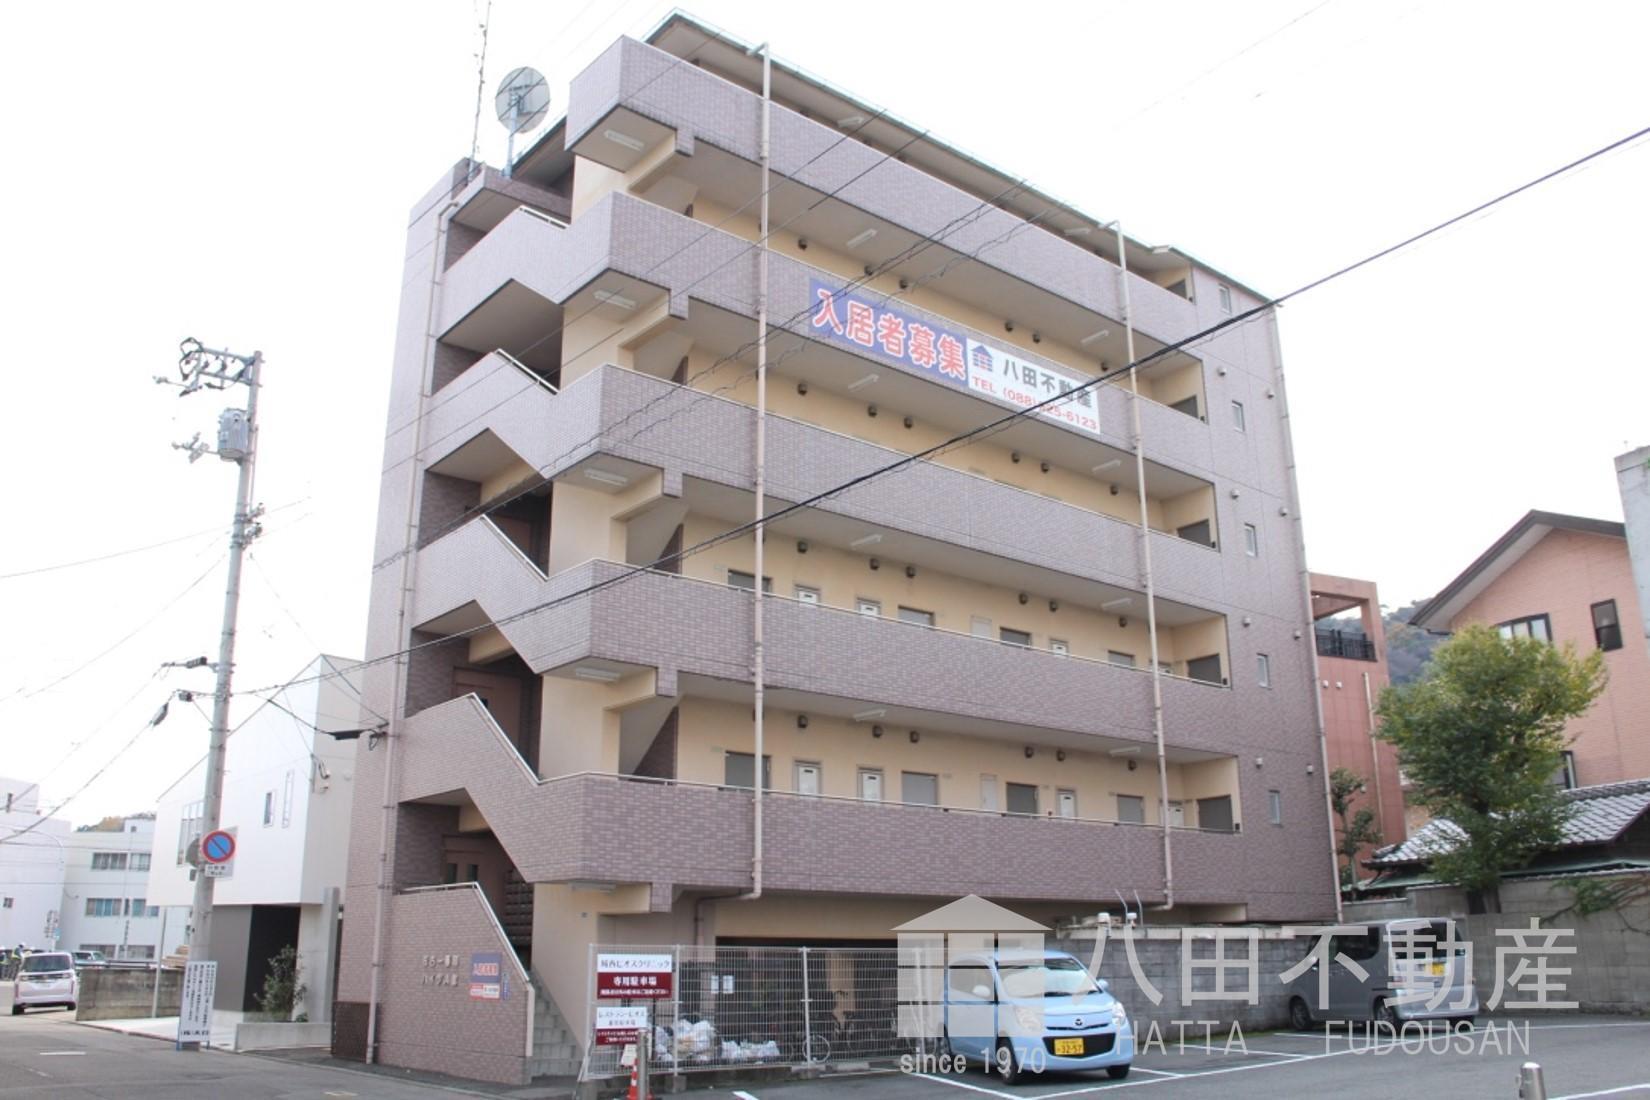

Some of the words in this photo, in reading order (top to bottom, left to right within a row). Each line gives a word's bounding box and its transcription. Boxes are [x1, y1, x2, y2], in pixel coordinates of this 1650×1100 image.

[812, 288, 966, 380] 入居者募集
[972, 376, 997, 393] TEL
[1003, 359, 1092, 408] 八田不動産
